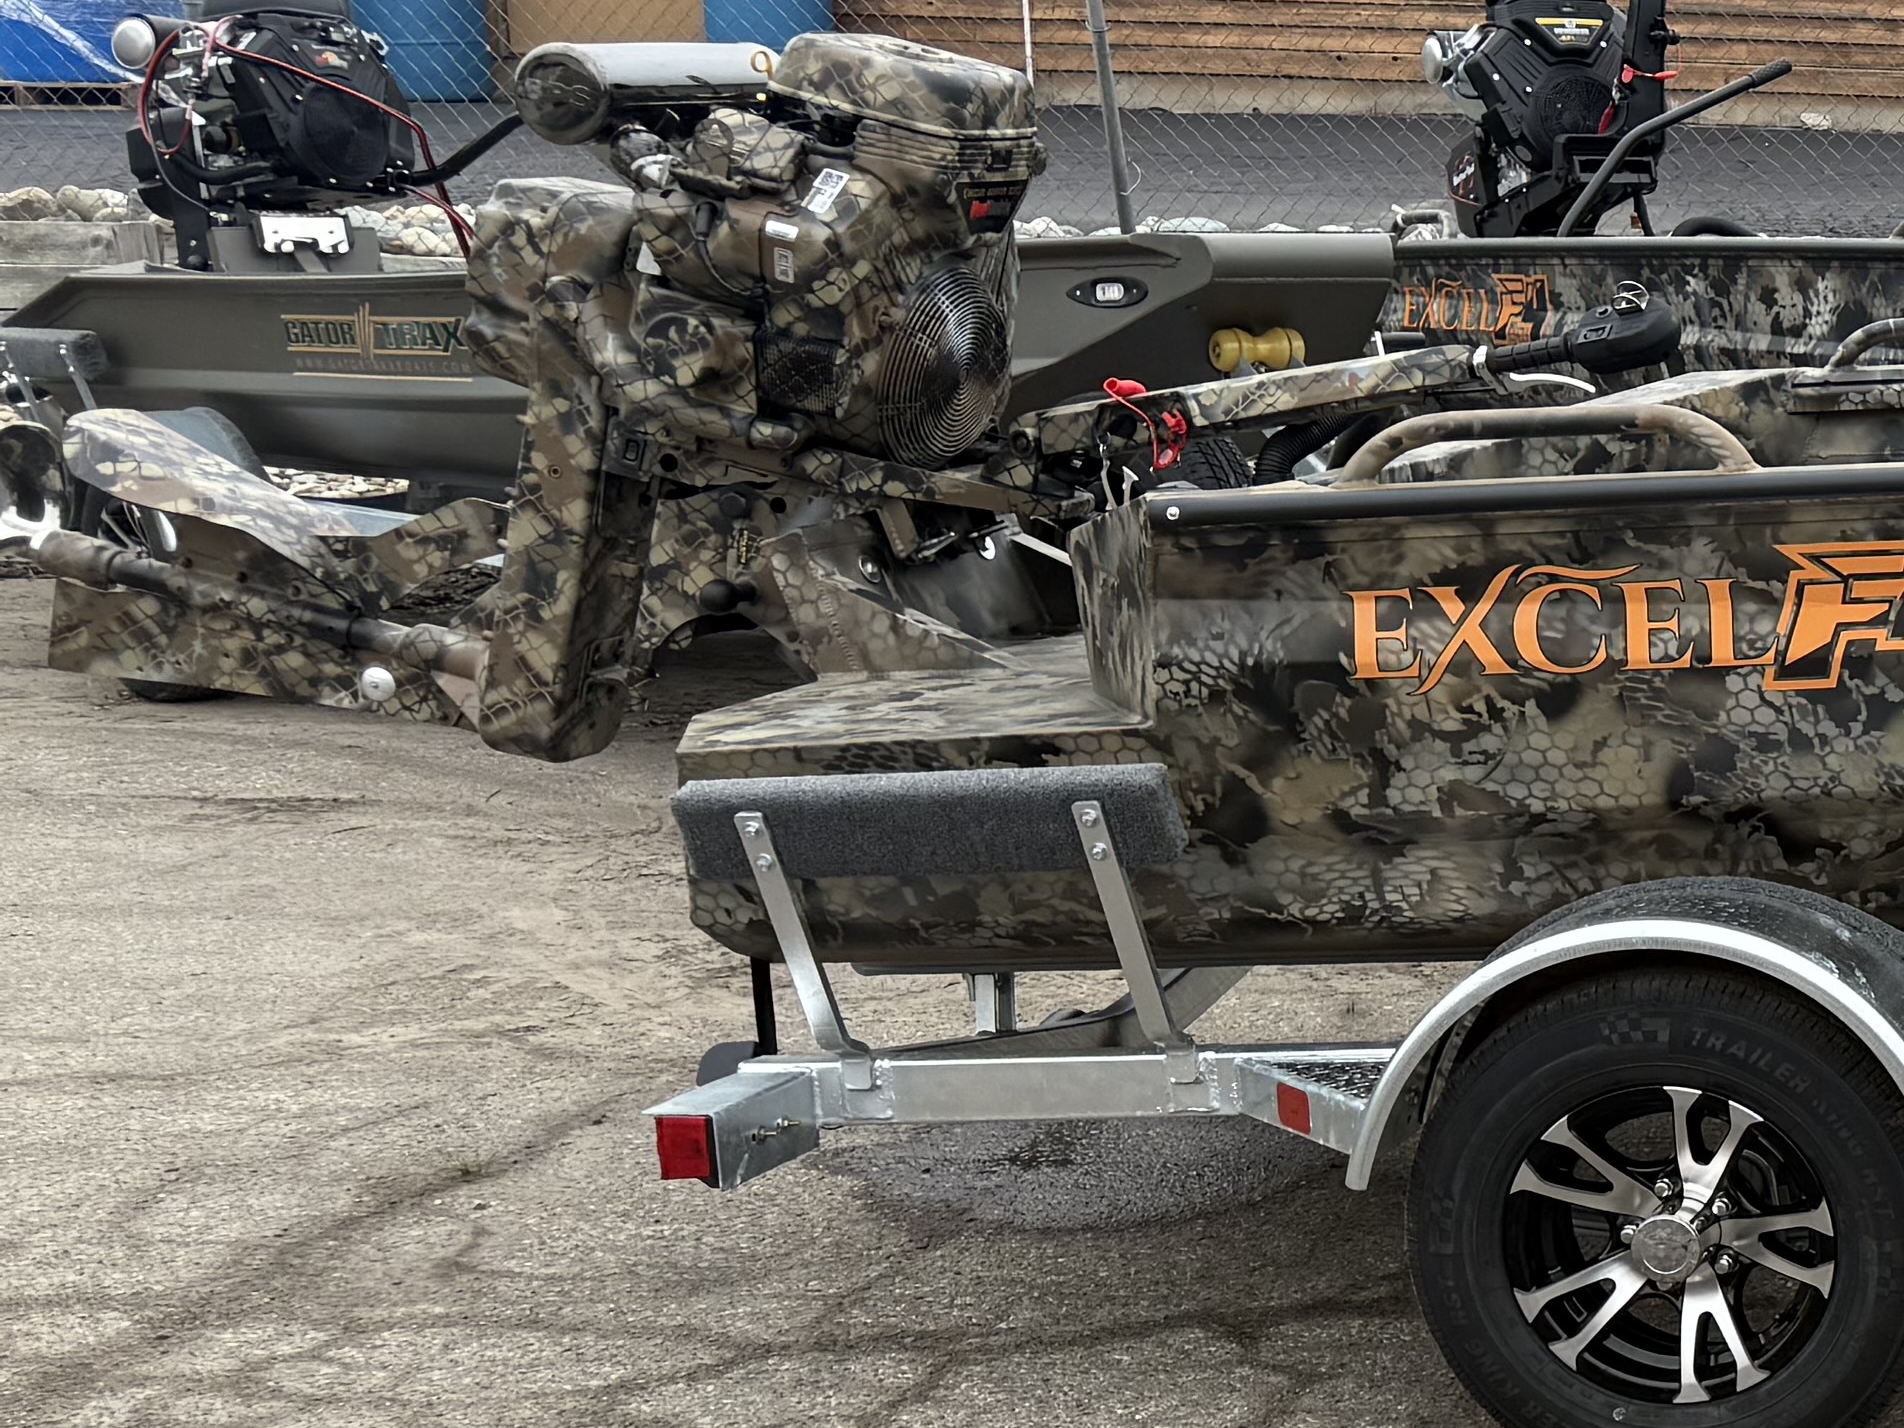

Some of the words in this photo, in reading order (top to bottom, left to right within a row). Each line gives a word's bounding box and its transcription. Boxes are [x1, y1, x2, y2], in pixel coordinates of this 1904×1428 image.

[1403, 277, 1499, 332] EXCEL
[285, 321, 357, 348] GATOR
[374, 318, 469, 353] TRAX
[1342, 562, 1781, 697] EXCEL
